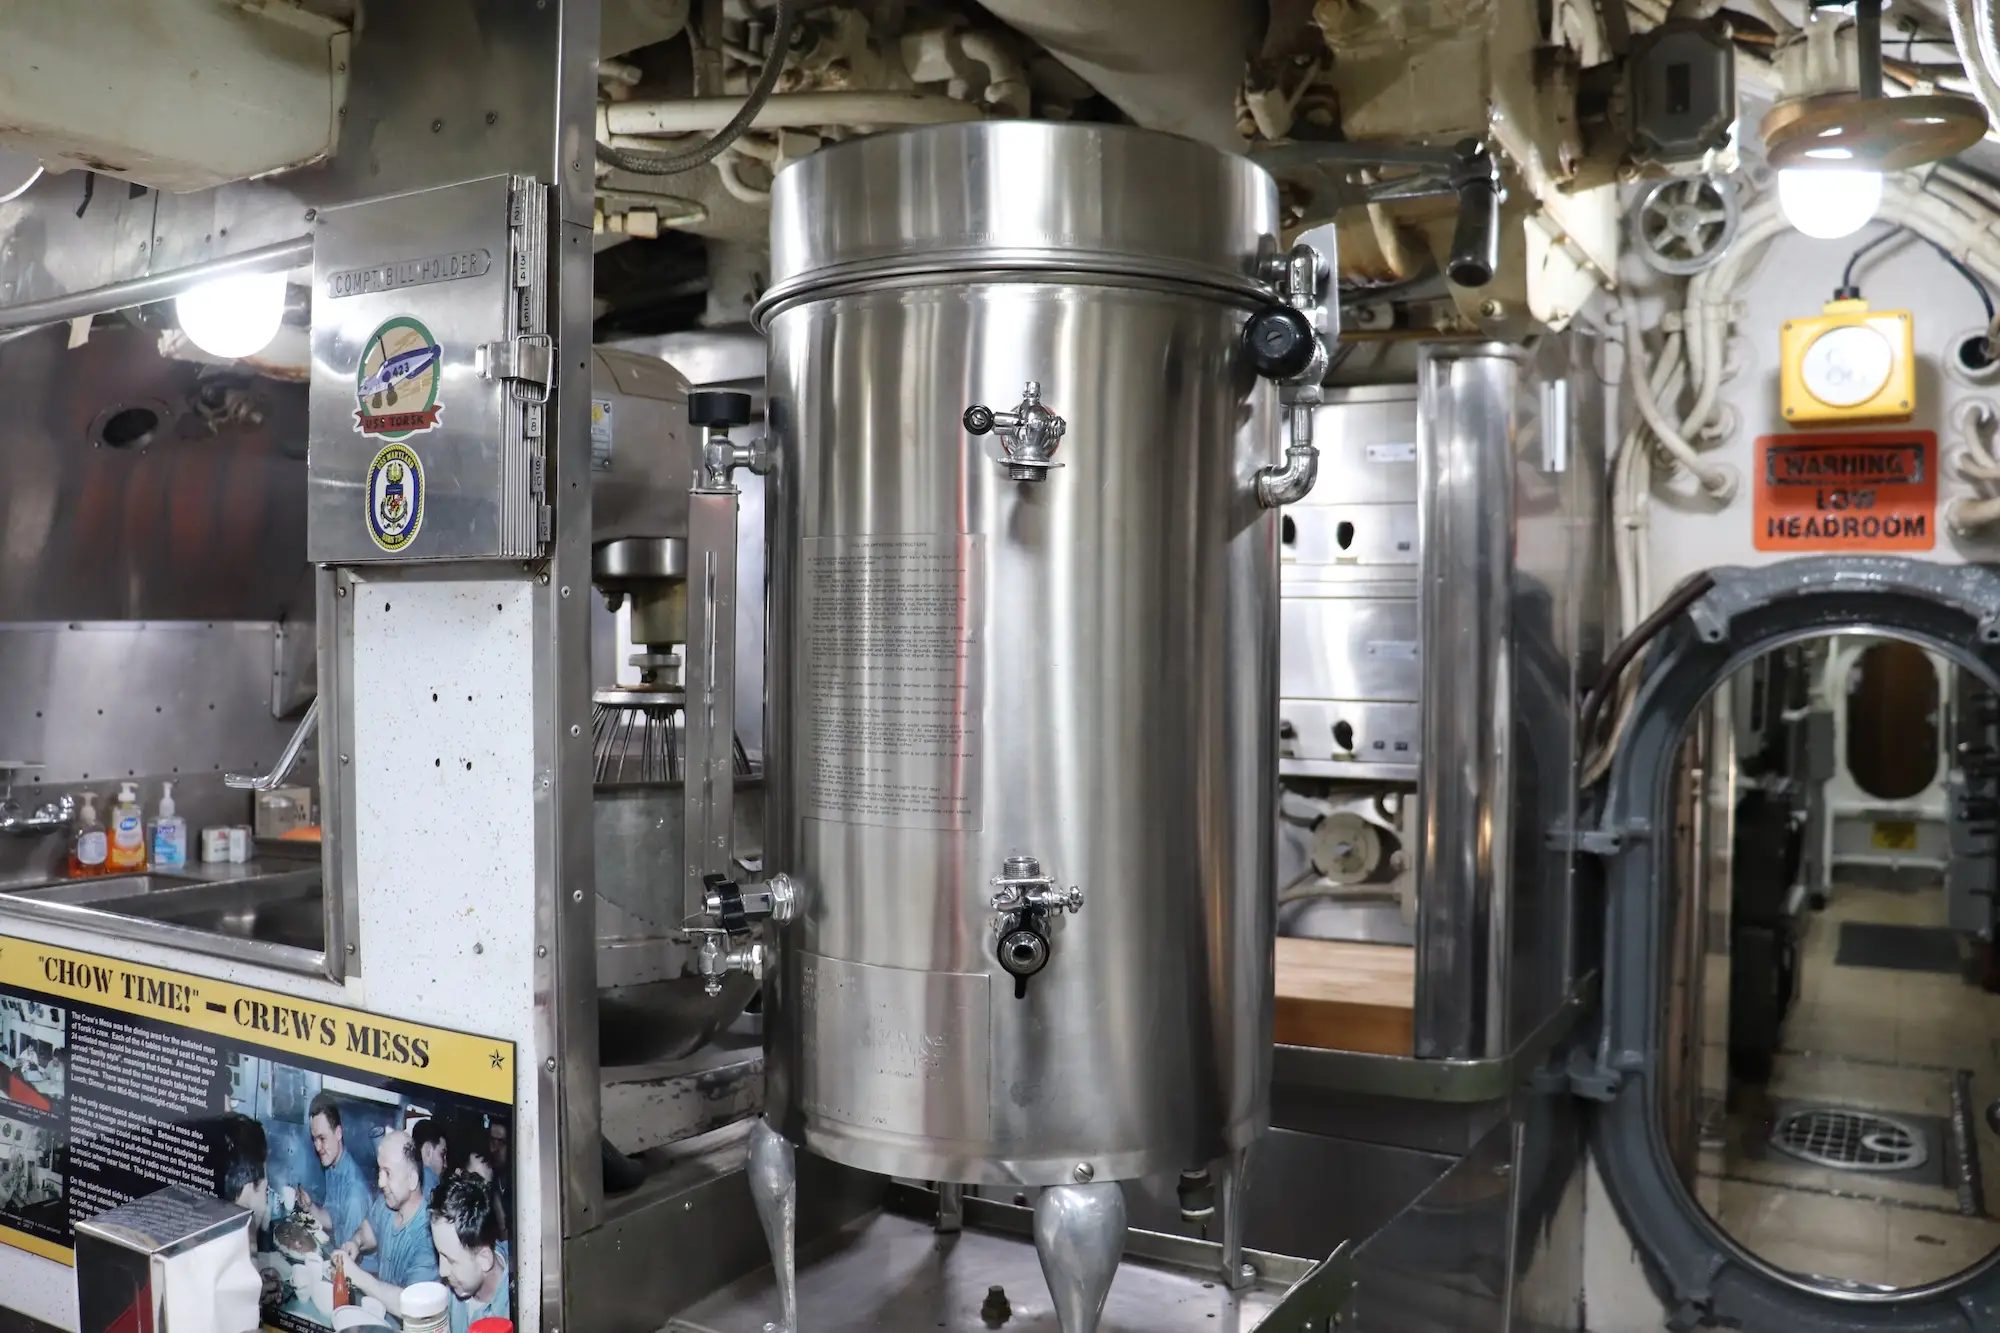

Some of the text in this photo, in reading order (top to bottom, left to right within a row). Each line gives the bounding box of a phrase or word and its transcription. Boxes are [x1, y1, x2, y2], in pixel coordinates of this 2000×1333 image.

[336, 253, 477, 294] COMPT. BILL HOLDER
[392, 362, 410, 378] 423
[365, 416, 424, 429] USS TORSK
[1785, 454, 1904, 476] WARNING
[1817, 489, 1876, 510] LOW
[1768, 514, 1925, 538] HEADROOM
[38, 956, 114, 994] "CHOW
[120, 972, 199, 1014] TIME!"
[346, 1022, 429, 1068] MESS
[72, 1011, 81, 1020] The
[82, 1013, 98, 1024] Crew's
[99, 1018, 112, 1028] Mess
[133, 1026, 149, 1039] dining
[150, 1032, 161, 1041] area
[181, 1040, 202, 1051] enlisted
[203, 1046, 215, 1054] men
[96, 1029, 109, 1038] crew.
[112, 1031, 124, 1042] Each
[145, 1040, 161, 1051] tables
[162, 1046, 178, 1056] would
[179, 1051, 190, 1059] seat
[71, 1043, 88, 1053] served
[124, 1057, 145, 1070] meaning
[146, 1061, 157, 1071] that
[158, 1064, 169, 1075] food
[182, 1072, 200, 1083] served
[78, 1034, 97, 1045] enlisted
[98, 1040, 109, 1048] men
[110, 1043, 124, 1052] could
[132, 1049, 149, 1059] seated
[161, 1055, 173, 1065] time.
[185, 1062, 201, 1072] meals
[202, 1067, 215, 1076] were
[91, 1058, 99, 1067] and
[107, 1061, 121, 1072] bowls
[122, 1067, 131, 1075] and
[142, 1072, 153, 1081] men
[160, 1078, 172, 1087] each
[174, 1080, 187, 1090] table
[188, 1083, 206, 1096] helped
[103, 1071, 116, 1082] There
[118, 1076, 129, 1085] were
[131, 1078, 140, 1088] four
[142, 1083, 157, 1093] meals
[107, 1084, 116, 1092] and
[71, 1105, 87, 1116] served
[99, 1112, 116, 1125] lounge
[117, 1119, 127, 1128] and
[128, 1122, 140, 1132] work
[141, 1126, 153, 1136] area.
[158, 1130, 180, 1144] Between
[182, 1138, 197, 1149] meals
[198, 1143, 209, 1152] and
[87, 1100, 98, 1110] only
[99, 1103, 111, 1112] open
[113, 1107, 127, 1117] space
[149, 1116, 157, 1126] the
[158, 1120, 175, 1131] crew's
[176, 1126, 190, 1136] mess
[191, 1130, 203, 1140] also
[70, 1135, 80, 1144] side
[90, 1141, 110, 1155] showing
[112, 1149, 130, 1160] movies
[131, 1155, 141, 1163] and
[146, 1159, 159, 1169] radio
[160, 1164, 181, 1176] receiver
[191, 1172, 214, 1188] listening
[100, 1133, 114, 1144] There
[152, 1150, 168, 1161] screen
[188, 1161, 213, 1175] starboard
[117, 1129, 130, 1139] could
[132, 1134, 141, 1142] use
[142, 1135, 151, 1146] this
[153, 1140, 164, 1149] area
[174, 1146, 196, 1161] studying
[70, 1156, 100, 1172] early sixties.
[77, 1148, 91, 1158] music
[93, 1152, 105, 1162] when
[107, 1157, 117, 1166] near
[134, 1164, 143, 1174] The
[156, 1171, 166, 1182] box
